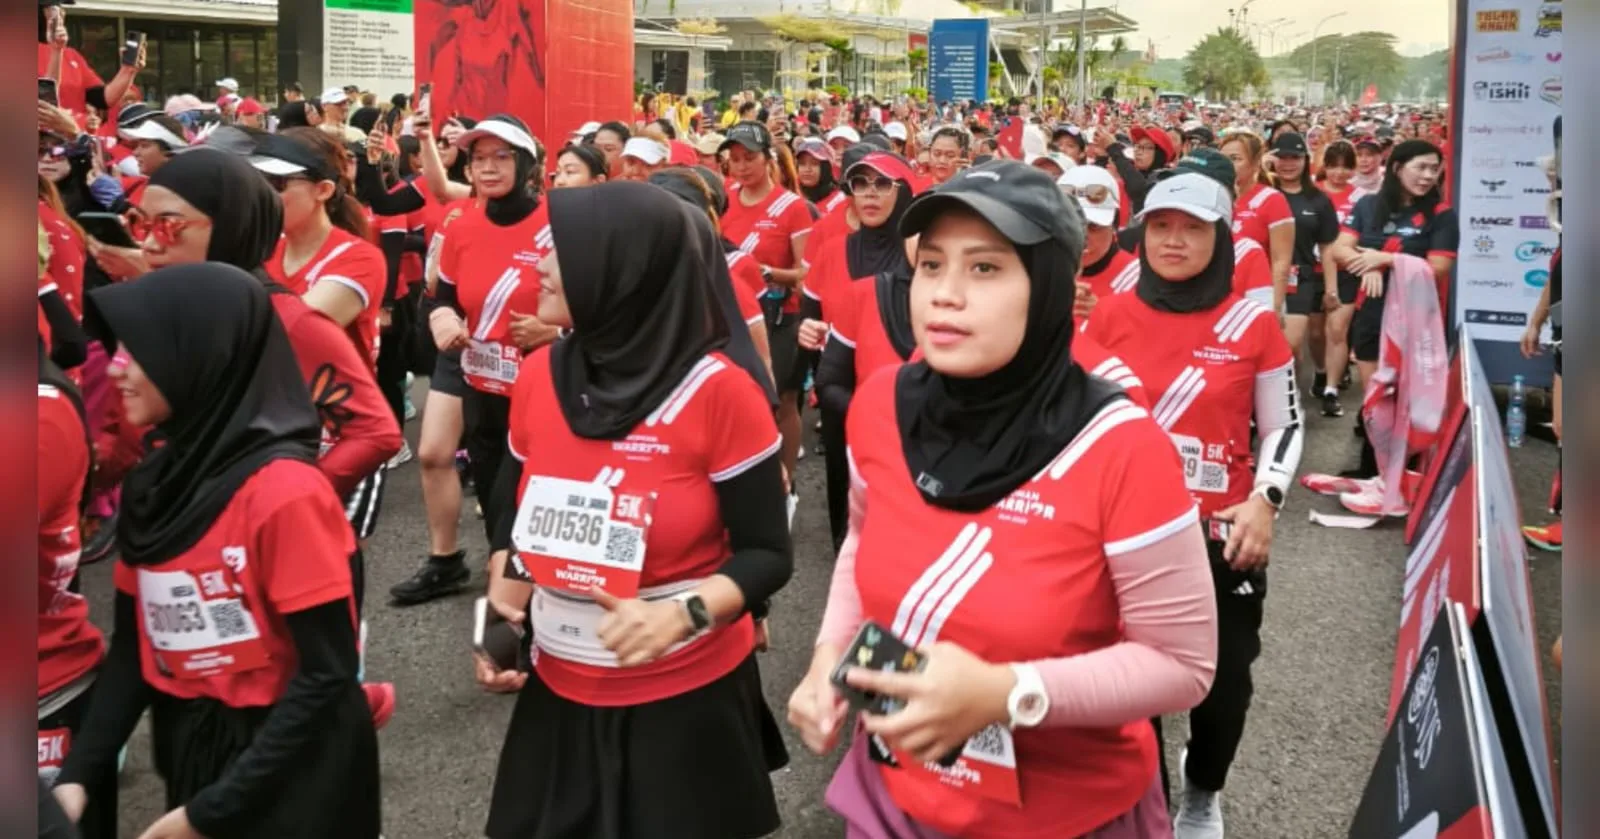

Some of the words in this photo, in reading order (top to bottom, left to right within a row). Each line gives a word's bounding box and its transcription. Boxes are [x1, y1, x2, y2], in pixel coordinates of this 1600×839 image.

[1207, 443, 1225, 460] 5K
[616, 494, 644, 519] 5K
[996, 498, 1056, 520] ARRIOR
[528, 505, 604, 546] 501536
[200, 570, 231, 596] 5K
[38, 735, 65, 762] 5K
